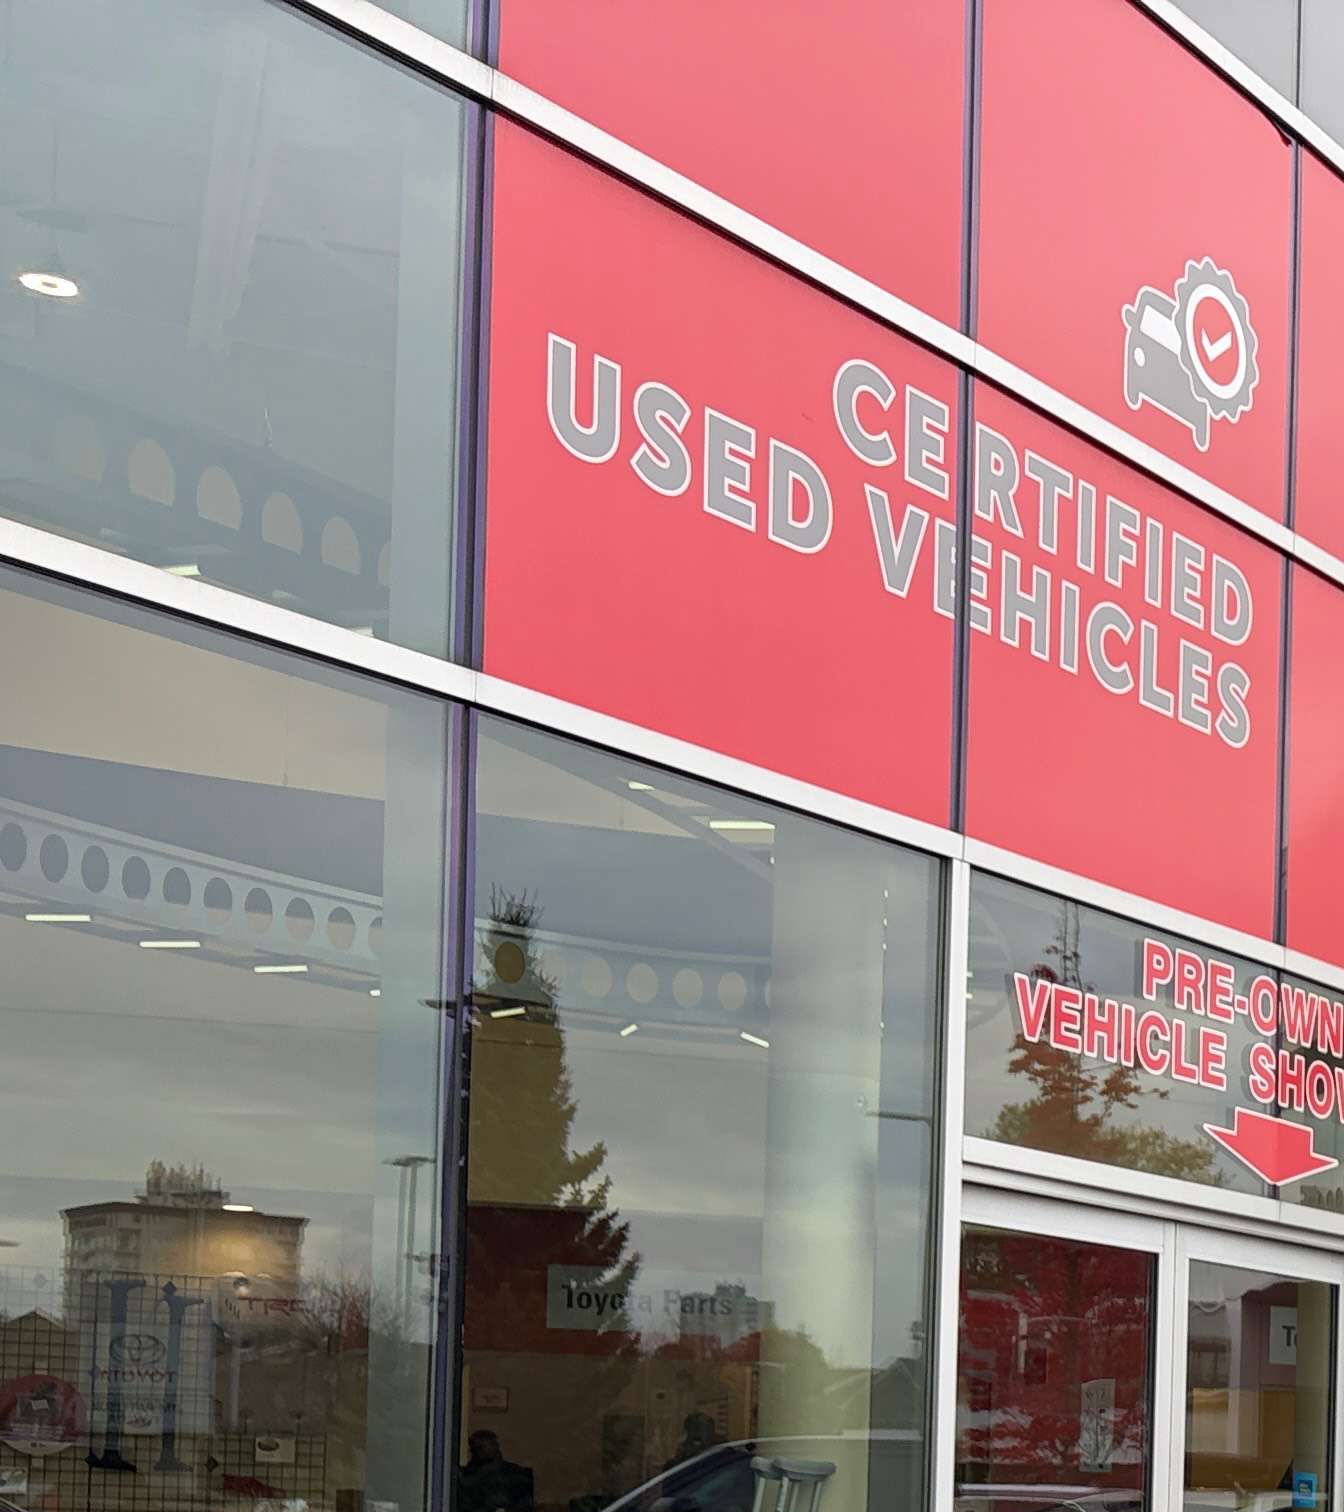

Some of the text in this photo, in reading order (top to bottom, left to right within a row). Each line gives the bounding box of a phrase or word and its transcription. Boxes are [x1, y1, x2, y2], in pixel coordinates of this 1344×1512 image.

[546, 332, 1251, 749] USED VEHICLES
[832, 359, 1254, 646] CERTIFIED
[1013, 972, 1228, 1091] VEHICLE
